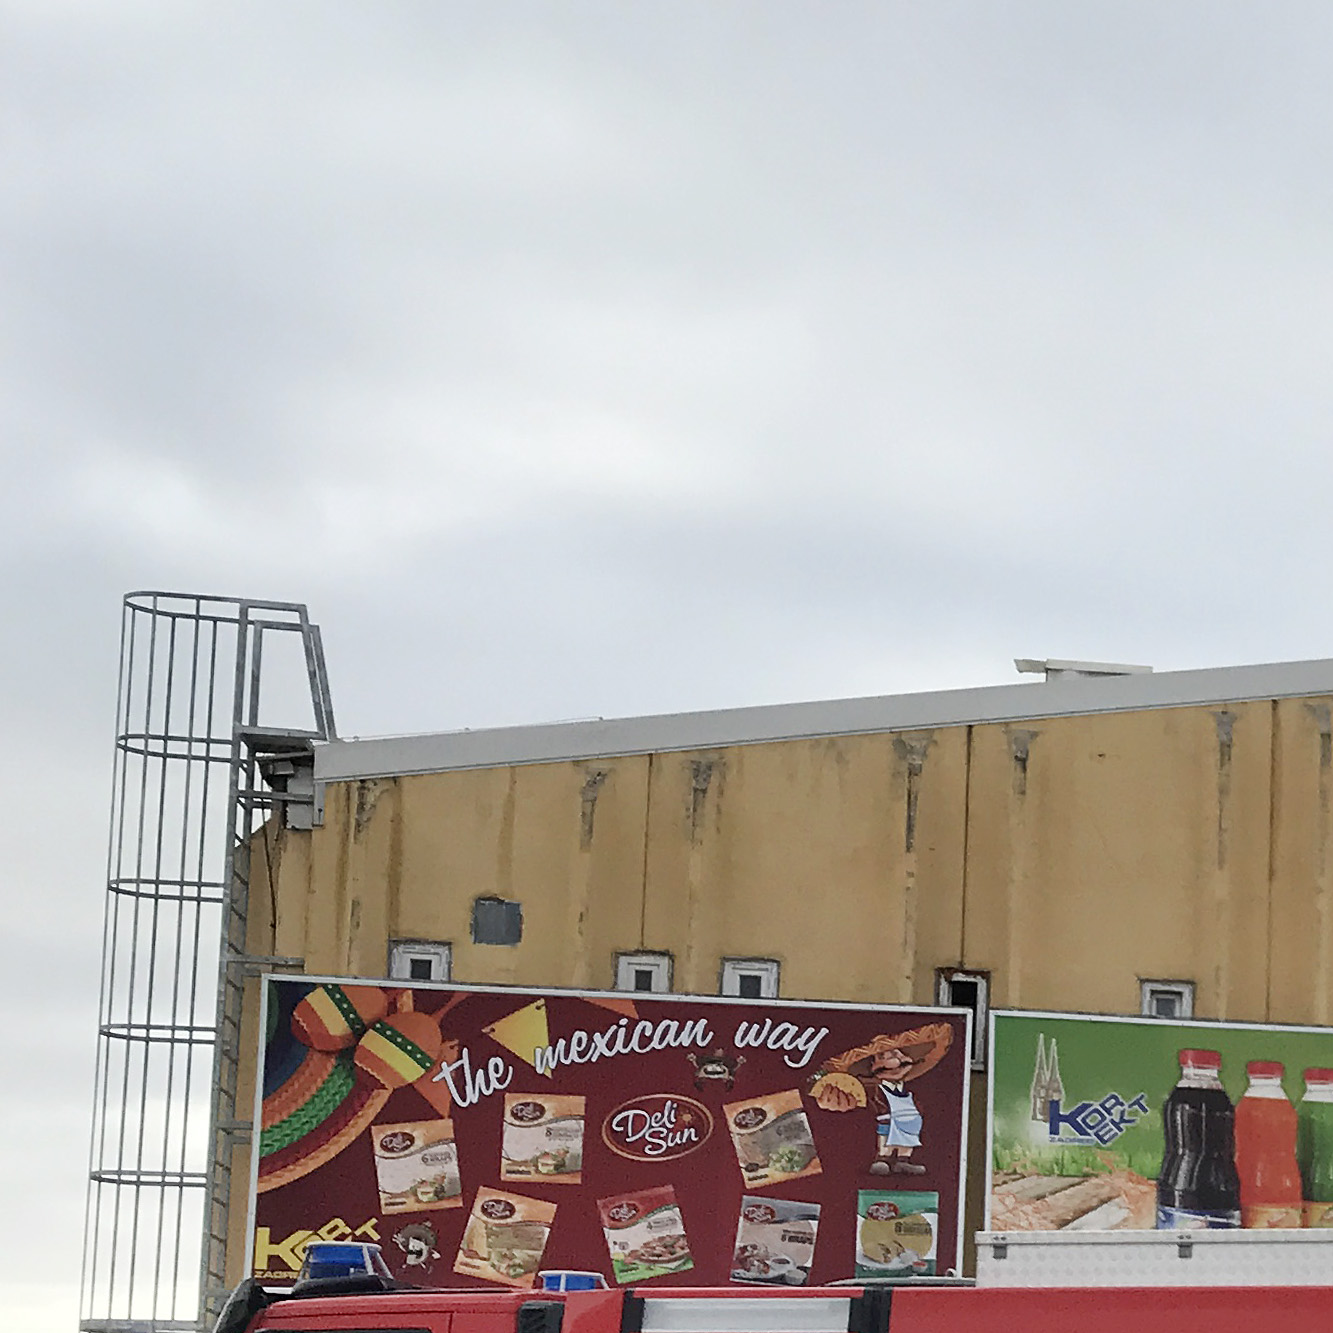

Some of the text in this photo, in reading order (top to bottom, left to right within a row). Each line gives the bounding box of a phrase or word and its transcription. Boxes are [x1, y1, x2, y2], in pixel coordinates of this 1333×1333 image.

[432, 1016, 829, 1108] the mexican way
[612, 1100, 677, 1142] Deli
[644, 1127, 699, 1155] Sun
